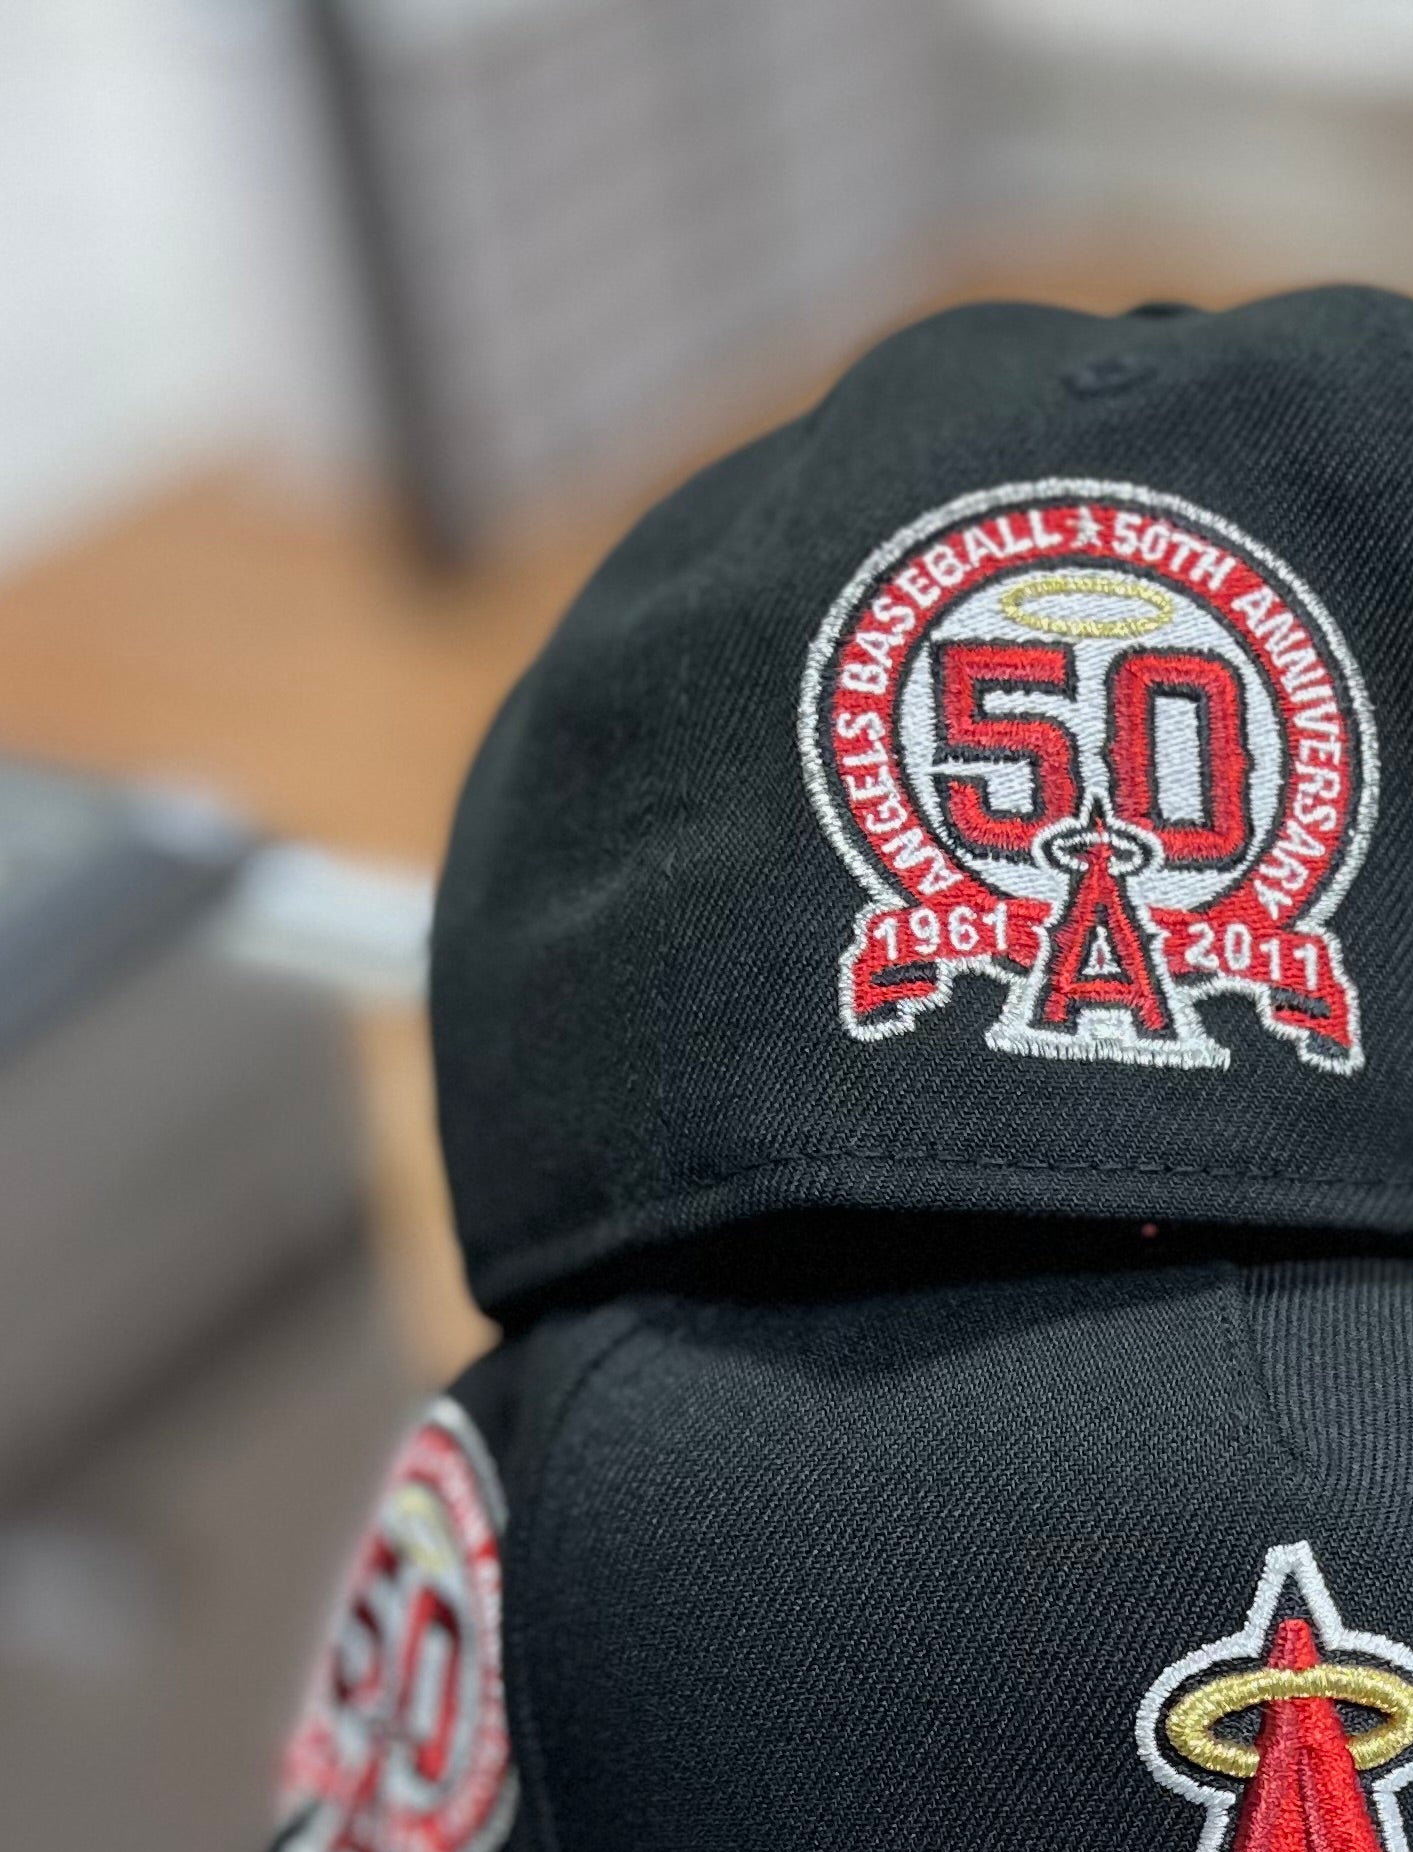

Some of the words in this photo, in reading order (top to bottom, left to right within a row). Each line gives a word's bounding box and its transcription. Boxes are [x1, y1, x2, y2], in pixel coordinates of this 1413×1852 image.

[841, 508, 1064, 696] BASEBALL
[1112, 511, 1236, 592] 50TH
[837, 711, 963, 899] ANGELS
[933, 639, 1253, 871] 50
[1230, 588, 1344, 919] ANNIVERSARY
[874, 902, 1010, 961] 1961
[1185, 922, 1320, 991] 2011
